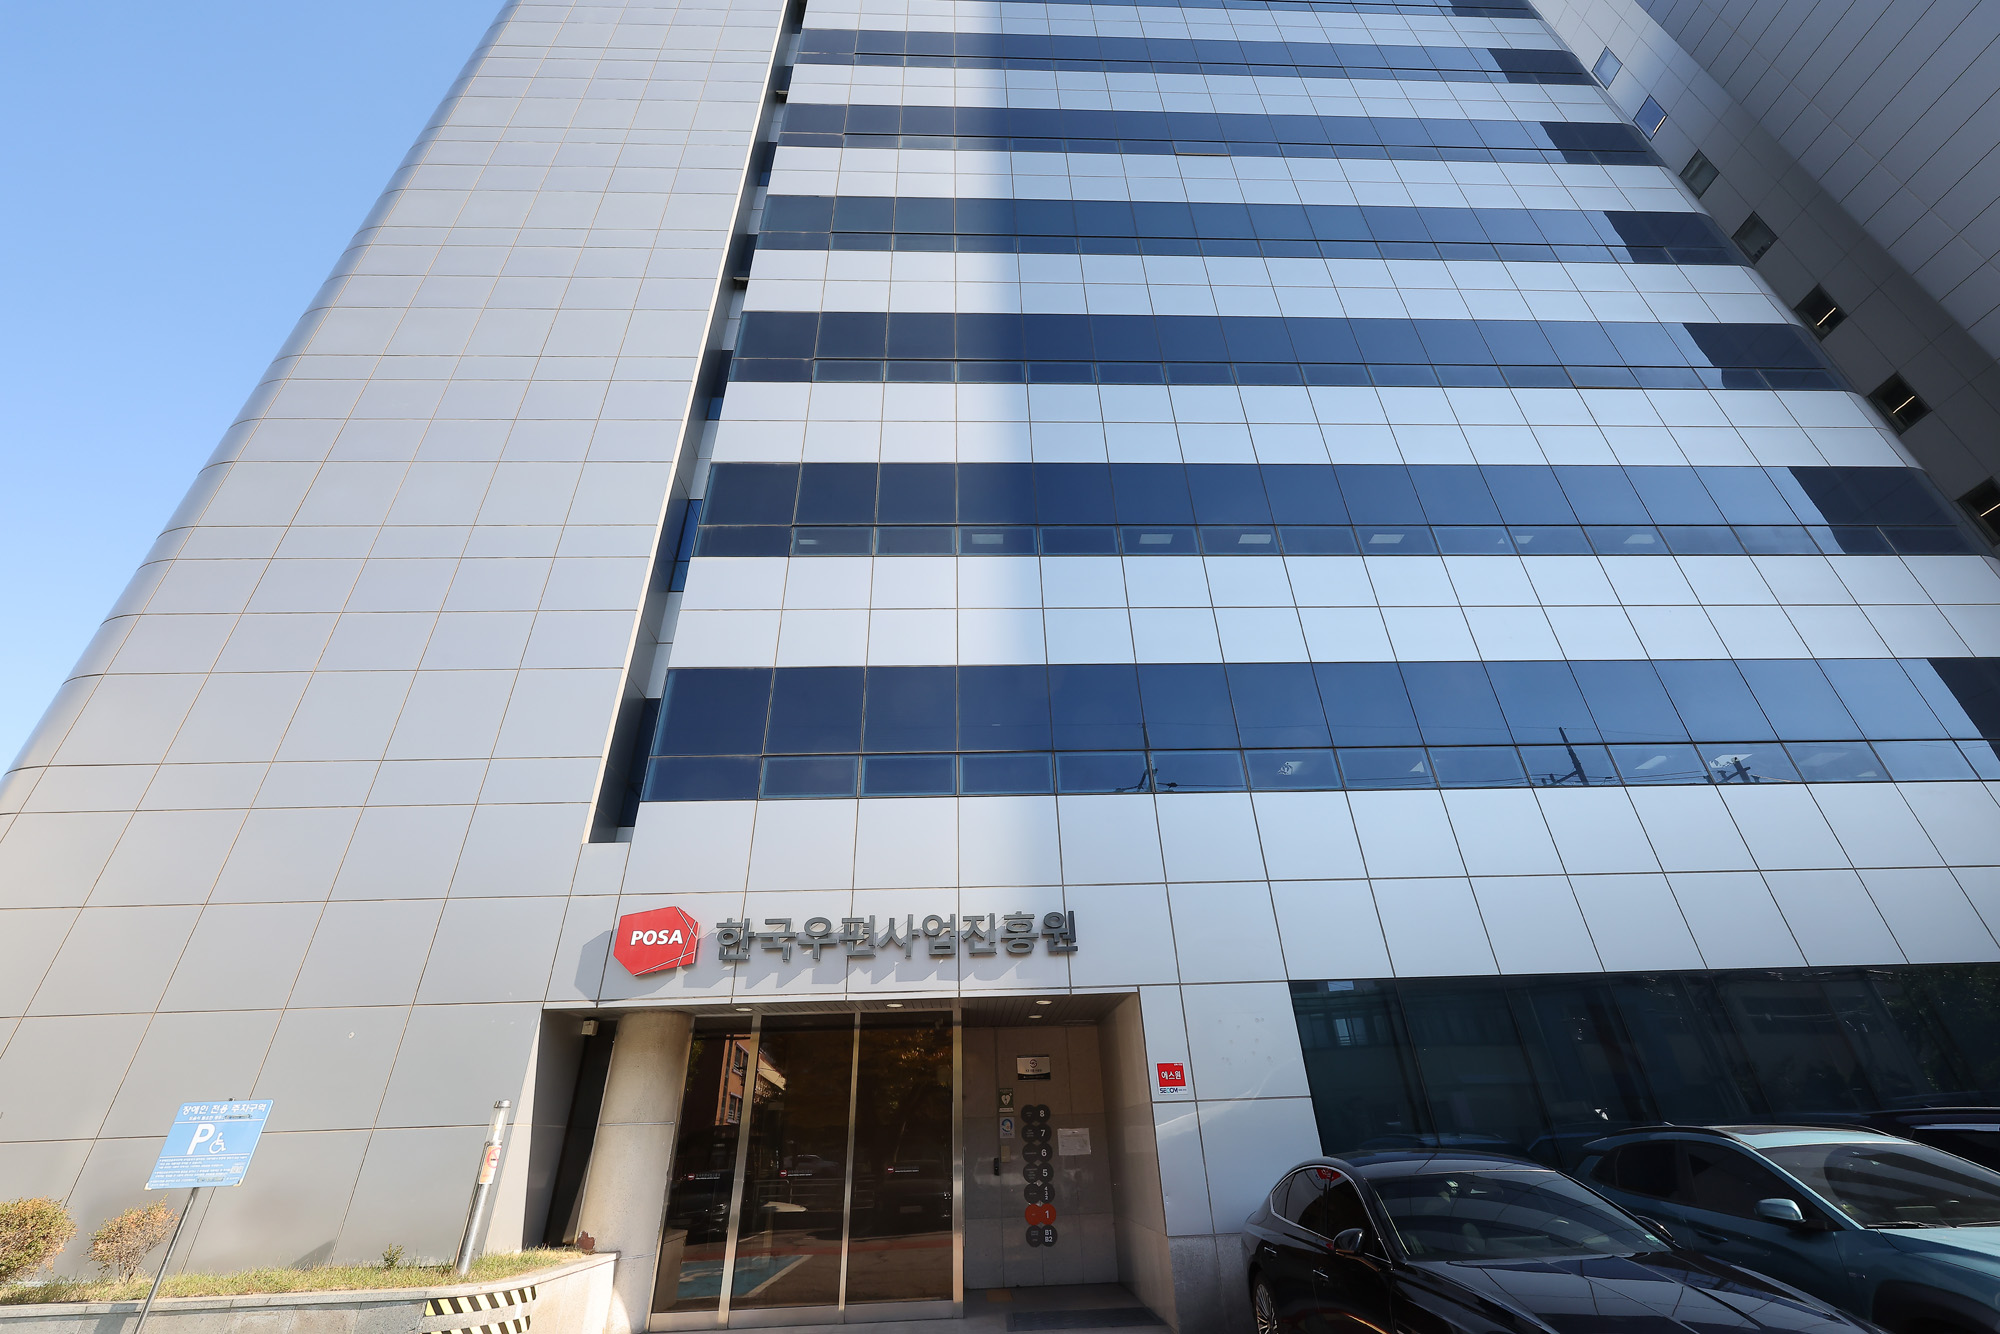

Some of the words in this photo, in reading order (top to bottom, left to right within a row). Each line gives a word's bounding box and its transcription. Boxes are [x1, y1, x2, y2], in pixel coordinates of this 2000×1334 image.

[630, 929, 684, 946] POSA
[716, 910, 1079, 964] 한국우편사업진흥원
[1160, 1070, 1182, 1080] 에스원
[182, 1104, 210, 1116] 장애인
[210, 1103, 229, 1115] 전용
[231, 1103, 267, 1113] 주차구역
[1039, 1109, 1045, 1118] 8
[1040, 1129, 1046, 1137] 7
[186, 1123, 216, 1156] P
[1041, 1148, 1047, 1157] 6
[1042, 1168, 1048, 1177] 5
[1044, 1210, 1050, 1219] 1
